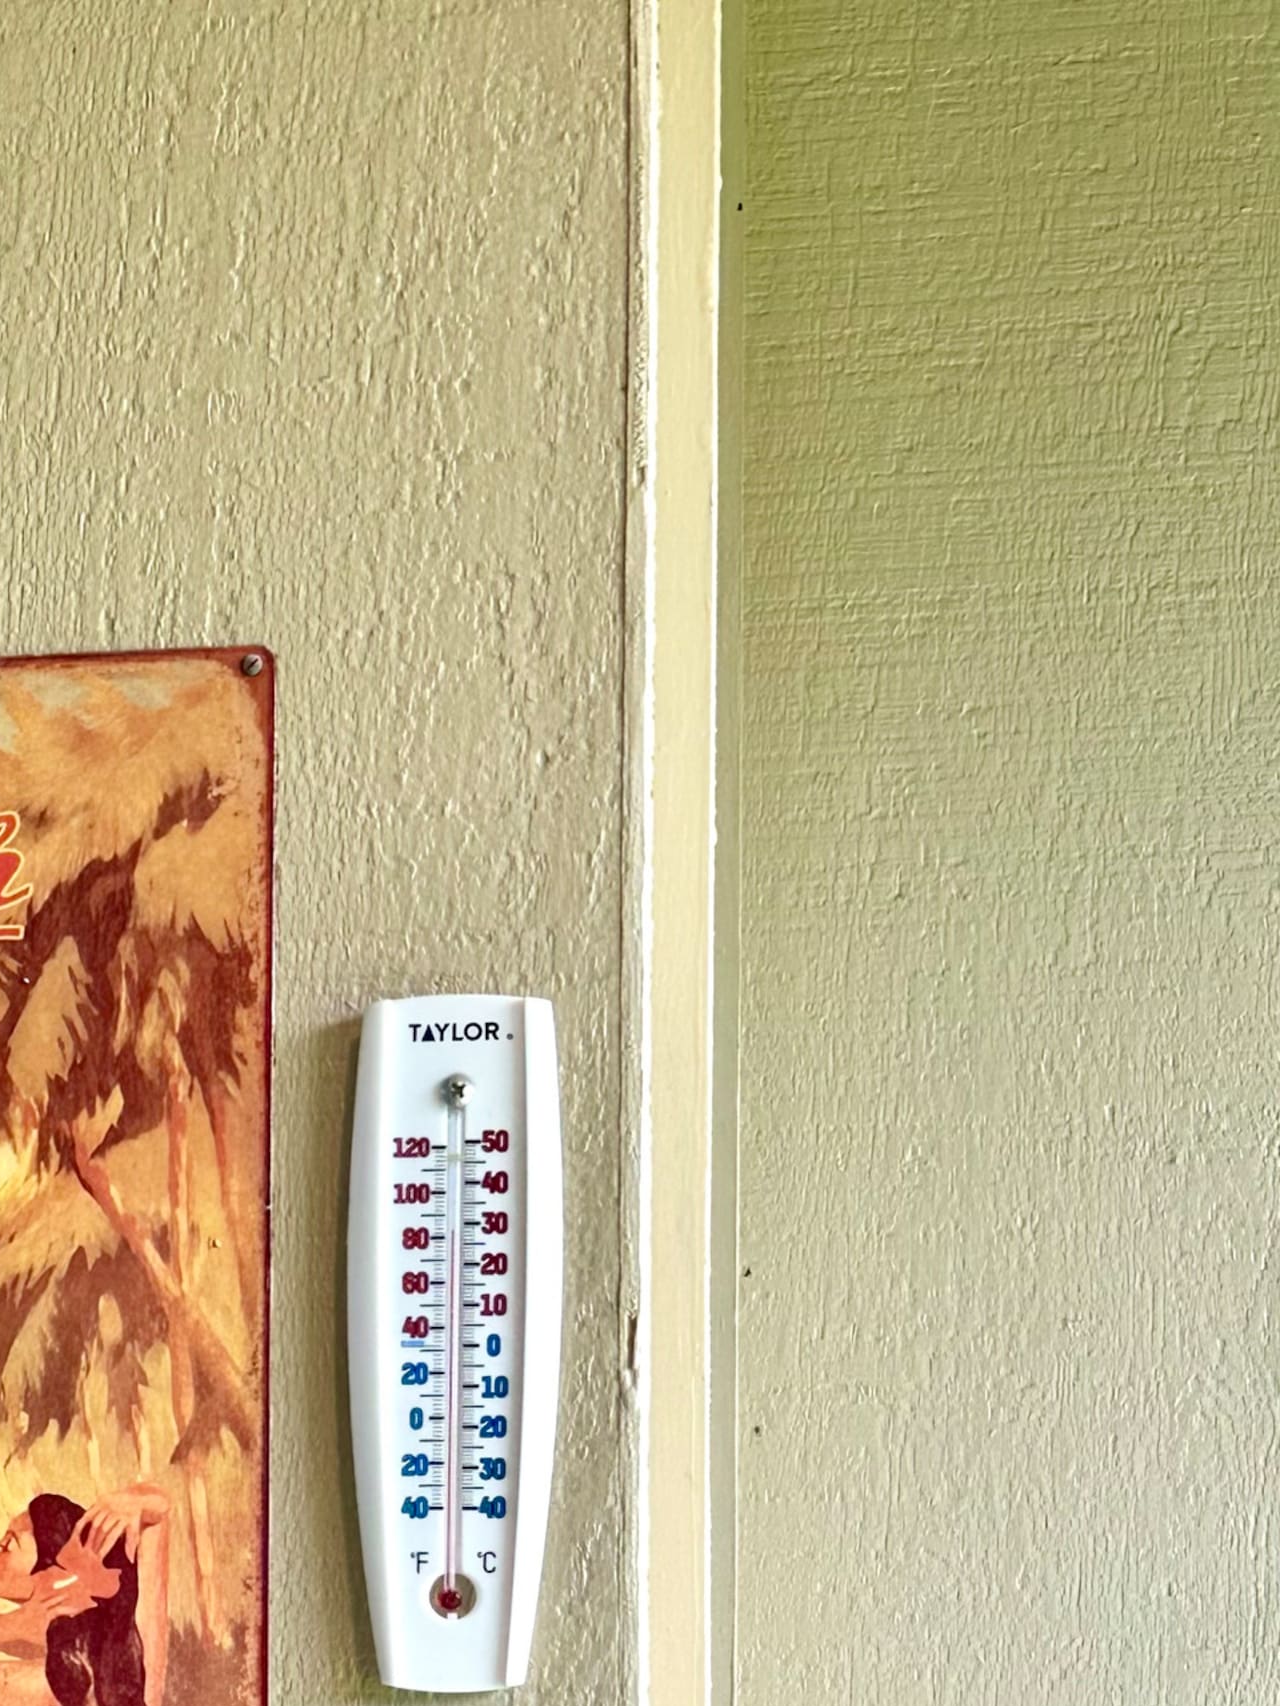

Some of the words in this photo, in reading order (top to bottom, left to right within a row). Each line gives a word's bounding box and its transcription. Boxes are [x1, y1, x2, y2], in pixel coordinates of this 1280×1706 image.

[408, 1021, 500, 1042] TAYLOR
[393, 1137, 430, 1158] 120
[482, 1130, 509, 1152] 50
[393, 1183, 430, 1204] 100
[481, 1171, 509, 1194] 40
[481, 1212, 508, 1234] 30
[402, 1227, 430, 1249] 80
[480, 1253, 508, 1275] 20
[402, 1272, 429, 1294] 60
[480, 1294, 507, 1316] 10
[402, 1317, 429, 1338] 40
[486, 1333, 501, 1357] 0
[401, 1362, 429, 1385] 20
[481, 1376, 509, 1398] 10
[409, 1407, 424, 1430] 0
[479, 1416, 507, 1438] 20
[401, 1454, 429, 1477] 20
[479, 1457, 507, 1480] 30
[401, 1496, 429, 1519] 40
[478, 1496, 507, 1519] 40
